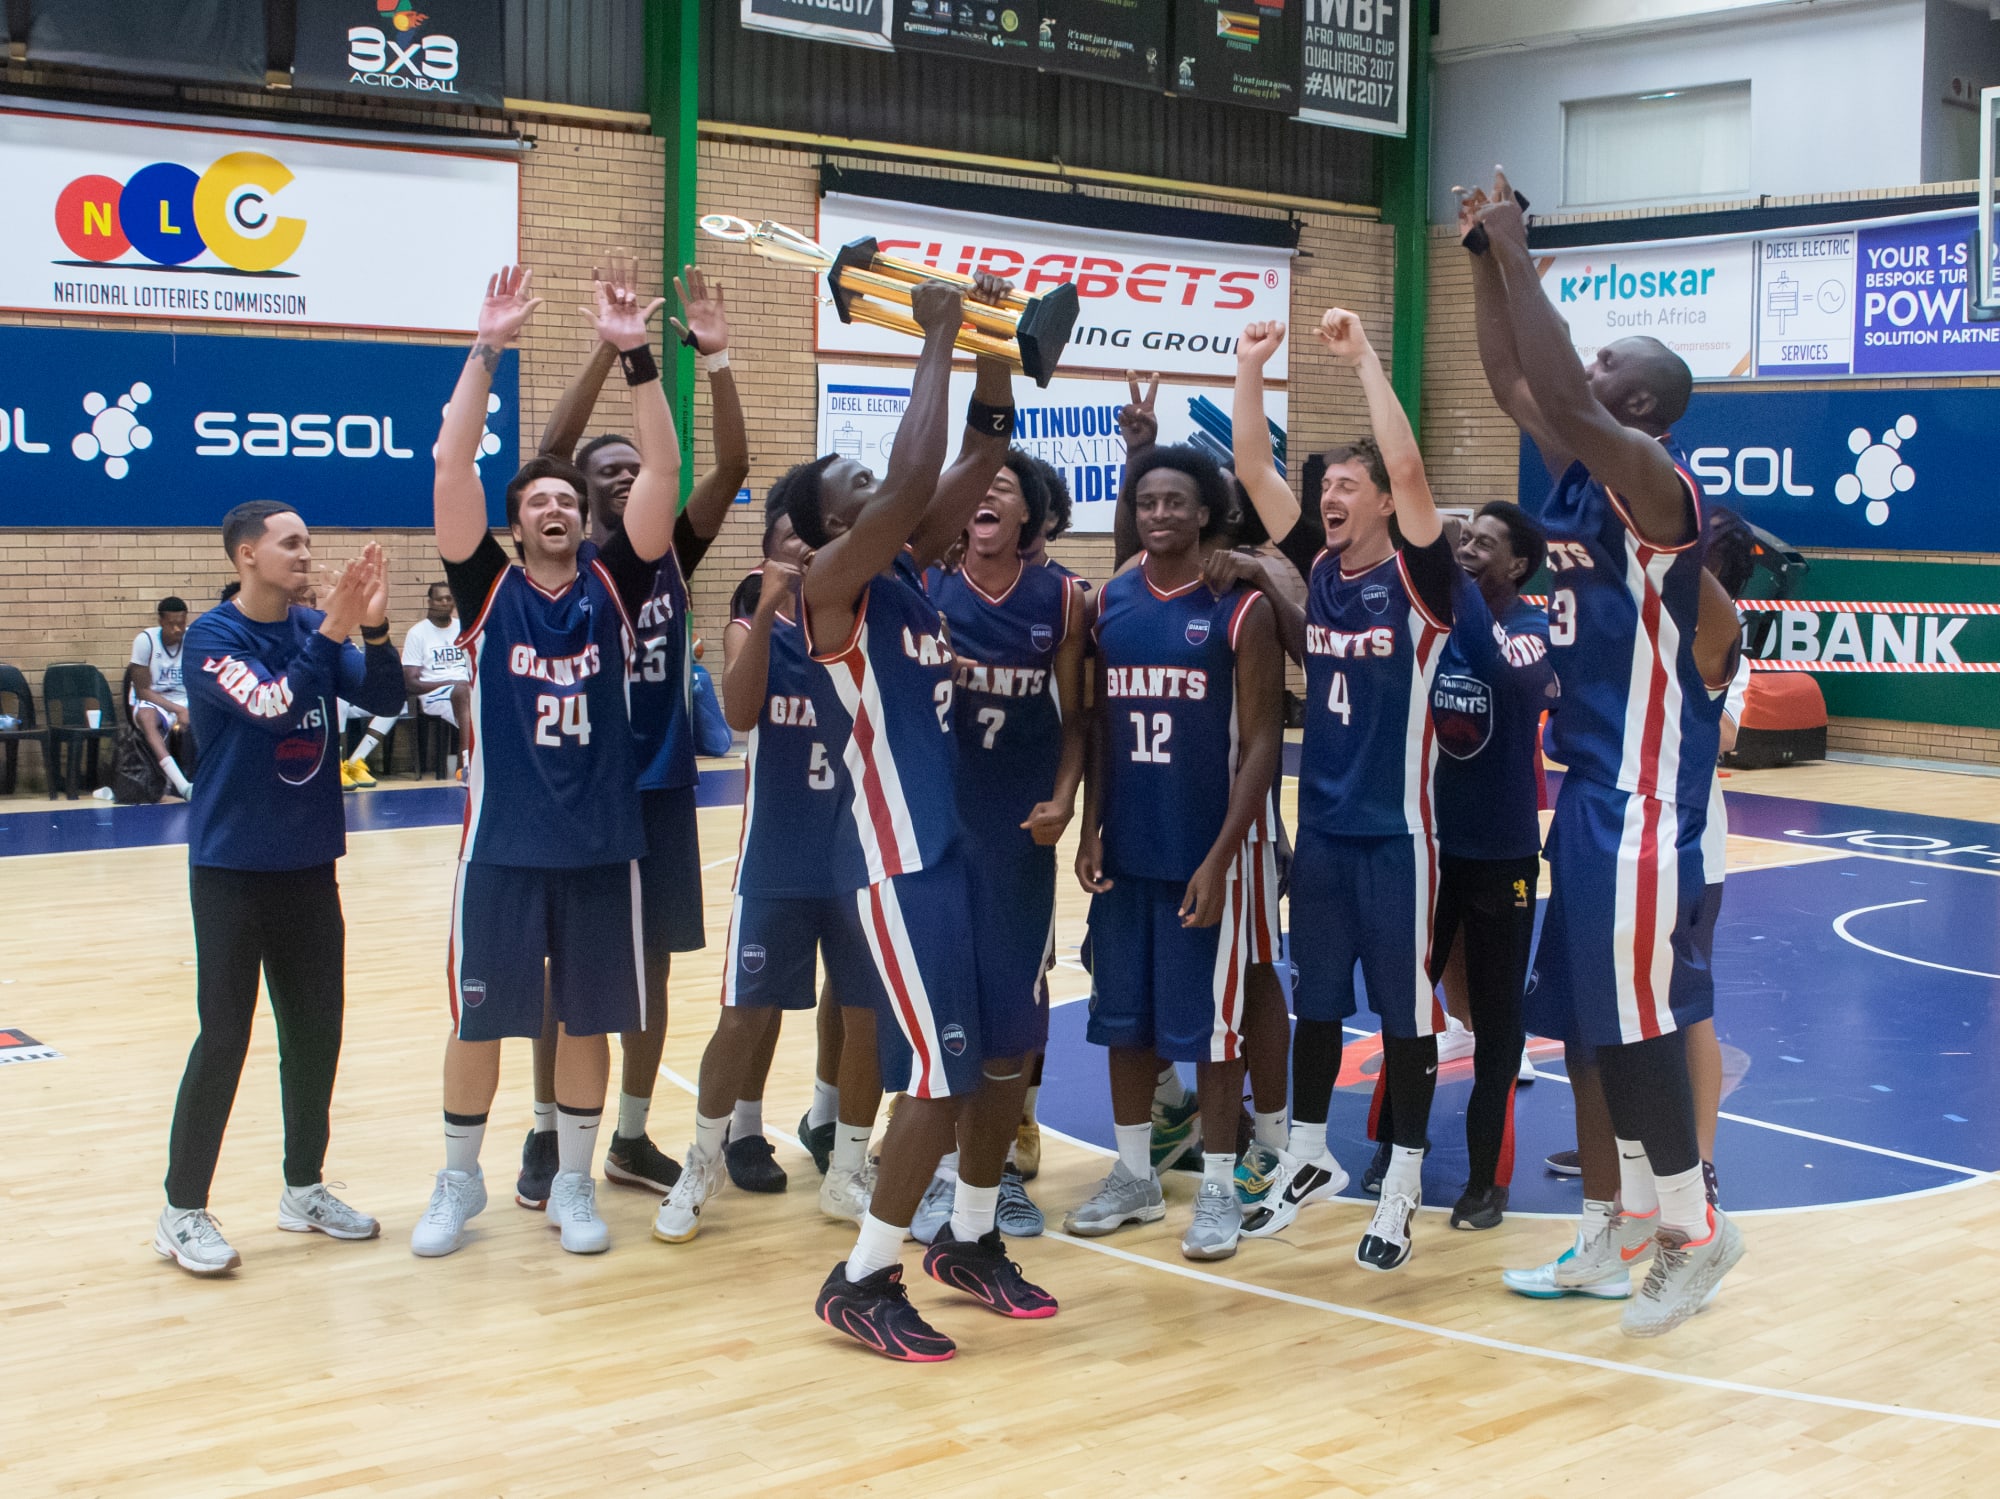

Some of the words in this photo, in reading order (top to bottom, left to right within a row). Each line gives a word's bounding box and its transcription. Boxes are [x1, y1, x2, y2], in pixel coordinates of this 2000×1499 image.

[1305, 26, 1333, 45] AFRO
[1337, 32, 1372, 53] WORLD
[1375, 38, 1395, 56] CUP
[1305, 46, 1367, 76] QUALIFIERS
[1369, 57, 1394, 80] 2017
[349, 71, 459, 94] ACTIONBALL
[1305, 71, 1394, 107] #AWC2017
[1765, 240, 1799, 260] DIESEL
[1801, 238, 1850, 257] ELECTRIC
[1867, 246, 1930, 269] YOUR
[1865, 270, 1935, 288] BESPOKE
[54, 282, 129, 306] NATIONAL
[133, 286, 209, 310] LOTTERIES
[214, 291, 306, 315] COMMISSION
[1606, 310, 1653, 327] South
[1657, 308, 1707, 325] Africa
[1068, 326, 1132, 349] ING
[1142, 331, 1239, 355] GROU
[1667, 341, 1731, 353] Compressors
[1781, 344, 1828, 362] SERVICES
[1864, 330, 1938, 346] SOLUTION
[832, 397, 862, 411] DIESEL
[1306, 624, 1395, 659] GIANTS
[511, 643, 600, 687] GIANTS
[629, 635, 668, 682] 5
[1107, 667, 1208, 700] GIANTS
[1328, 672, 1352, 726] 4
[1434, 690, 1488, 714] GIANTS
[535, 694, 592, 747] 24
[977, 707, 1006, 750] 7
[1130, 711, 1172, 763] 12
